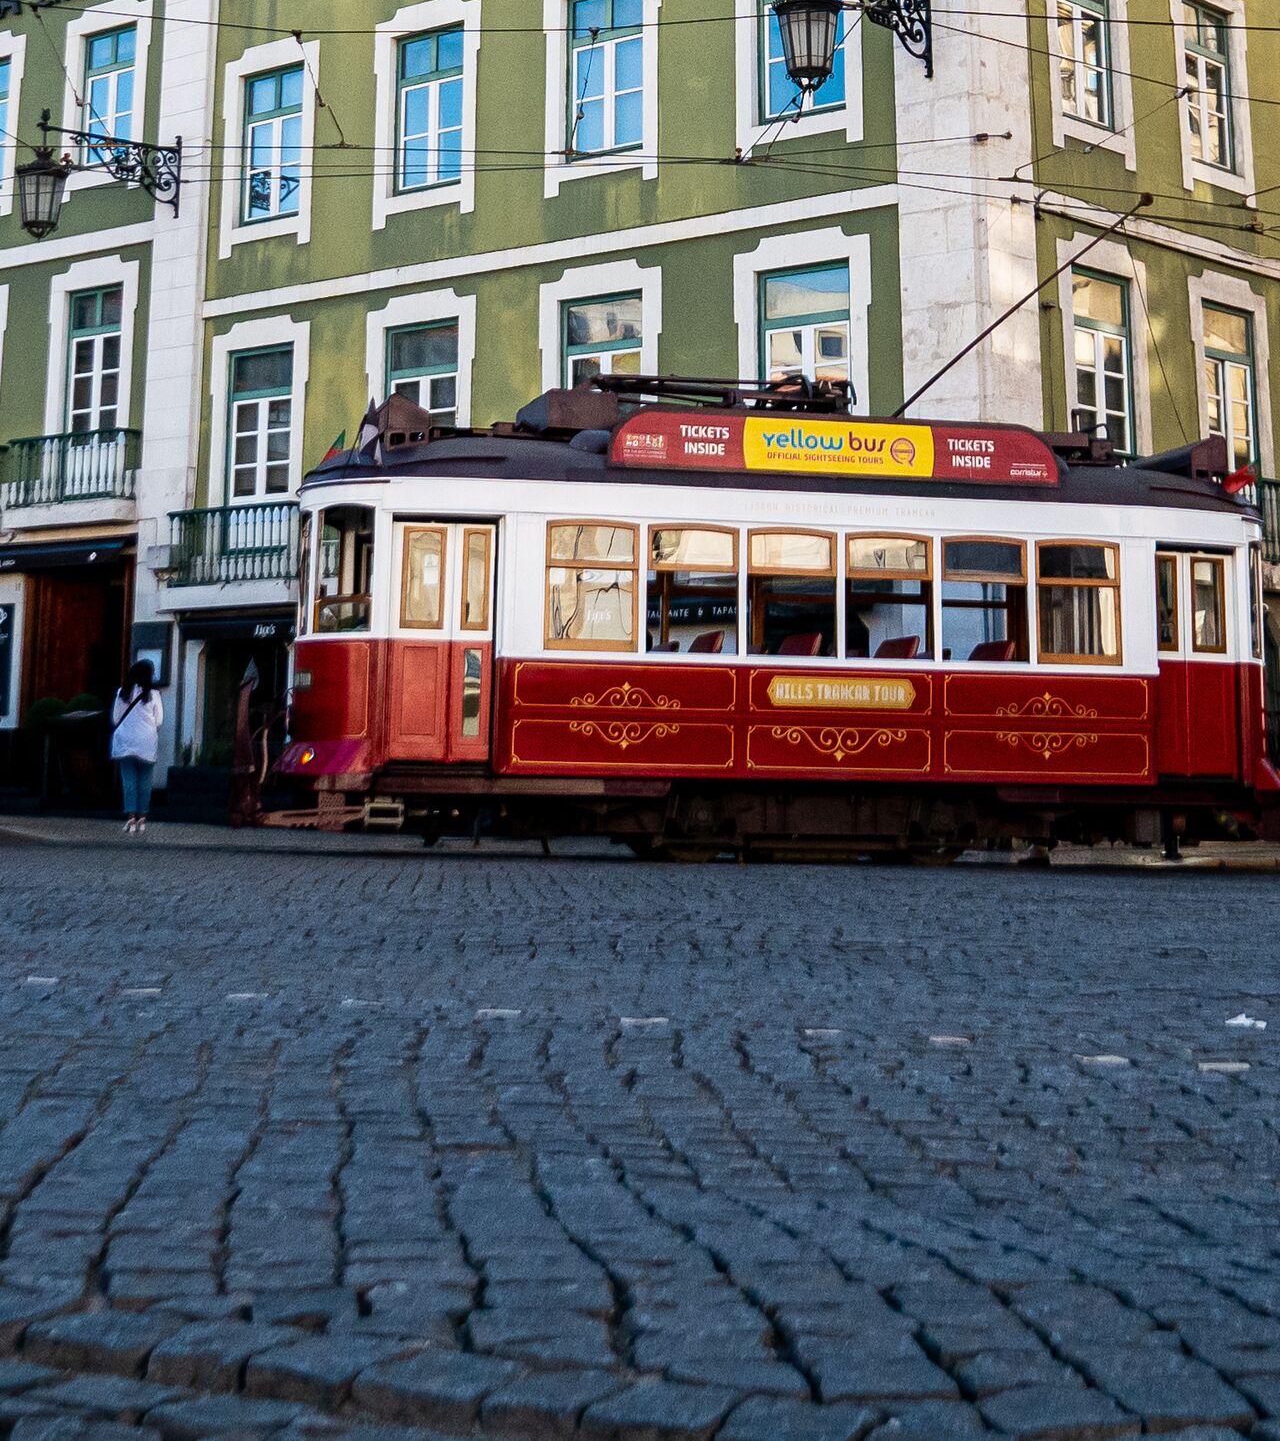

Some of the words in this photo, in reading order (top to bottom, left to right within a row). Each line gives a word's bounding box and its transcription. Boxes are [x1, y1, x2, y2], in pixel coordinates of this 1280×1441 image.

[680, 424, 730, 439] TICKETS
[762, 428, 844, 450] yellow
[848, 431, 886, 452] bus
[947, 438, 995, 453] TICKETS
[684, 441, 726, 456] INSIDE
[767, 451, 801, 461] OFFICIAL
[804, 453, 856, 464] SIGHTSEEING
[858, 456, 884, 464] TOURS
[952, 455, 991, 469] INSIDE
[785, 503, 840, 514] HISTORICAL
[847, 505, 888, 516] PREMIUM
[895, 507, 936, 518] TRAMCAR
[775, 683, 813, 701] HILLS
[873, 685, 907, 702] TOUR
